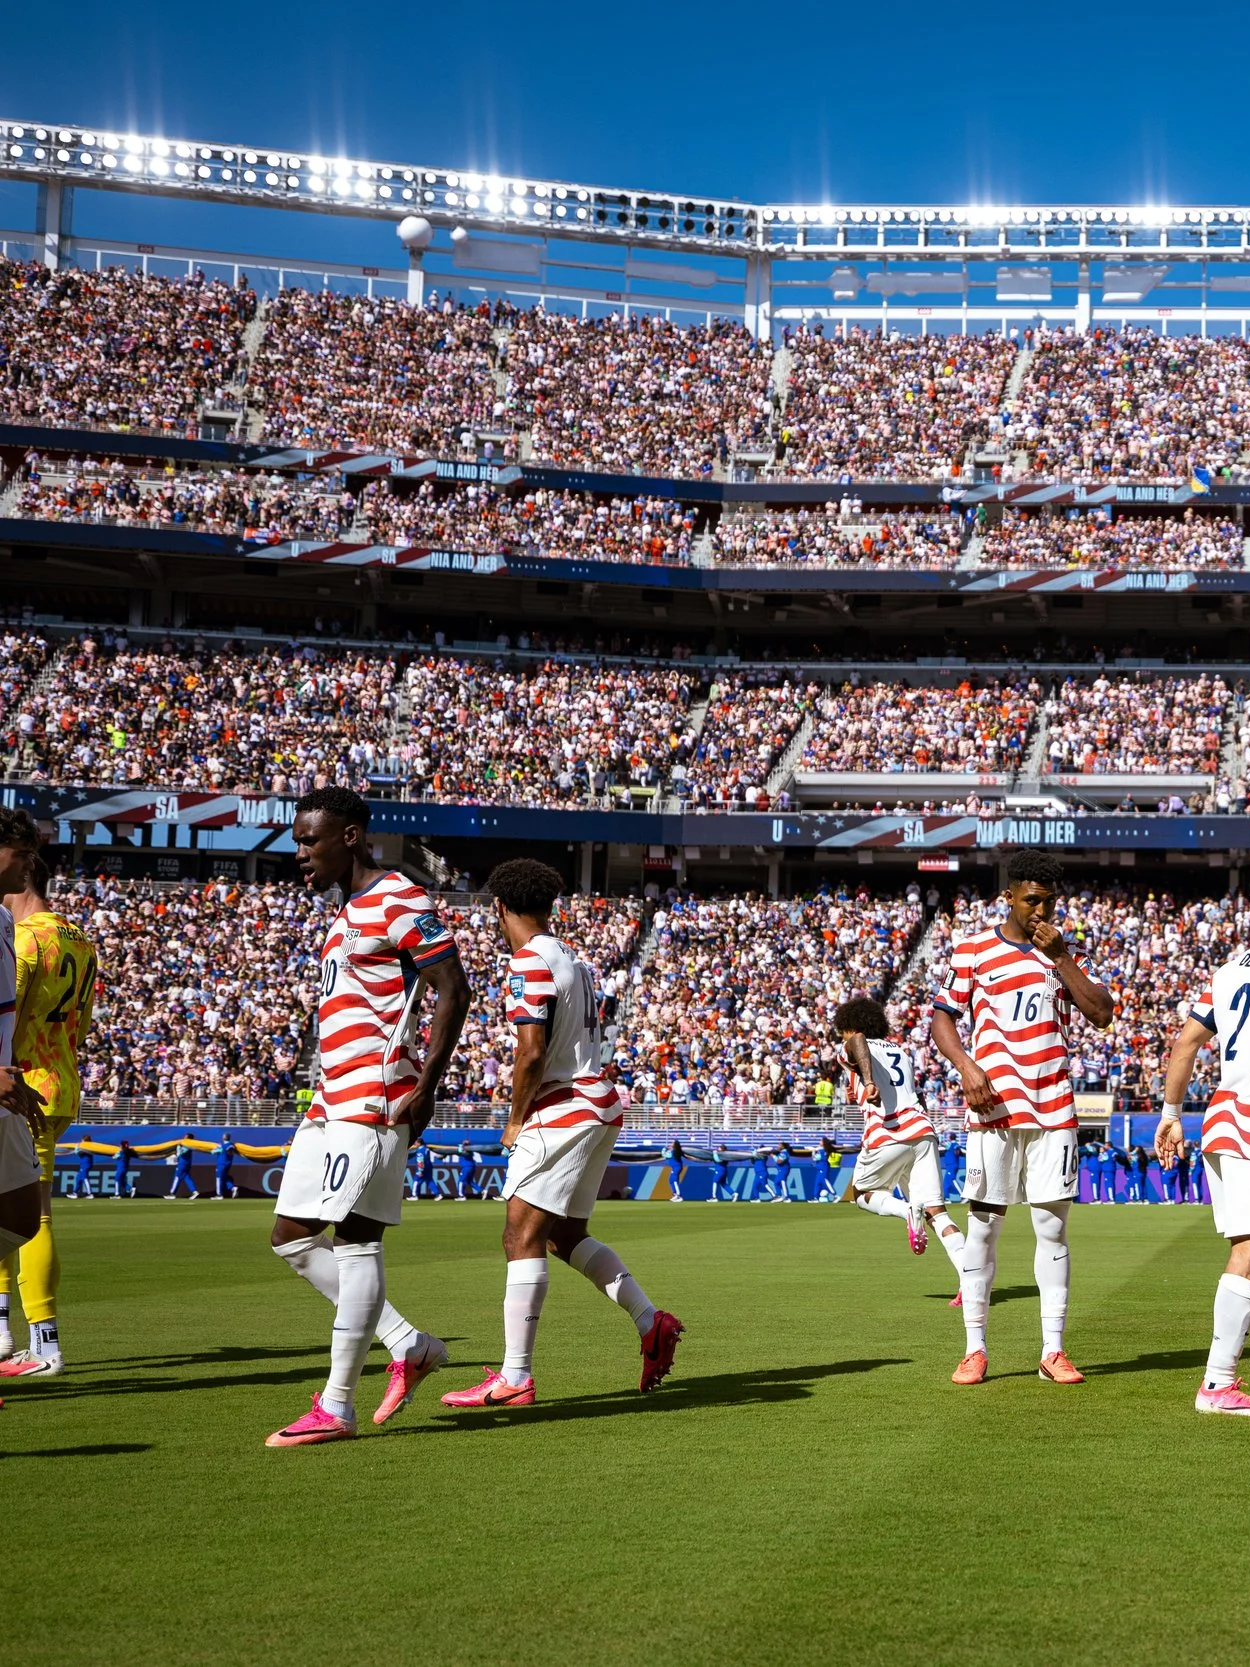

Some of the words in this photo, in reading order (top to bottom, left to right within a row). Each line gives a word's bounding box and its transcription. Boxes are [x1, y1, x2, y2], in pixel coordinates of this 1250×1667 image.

[273, 801, 298, 826] AN
[772, 819, 783, 843] U
[903, 819, 924, 843] SA
[976, 821, 1004, 844] NIA
[1008, 821, 1041, 844] AND
[1045, 820, 1075, 844] HER
[157, 857, 180, 867] FIFA
[213, 861, 239, 871] FIFA
[1012, 991, 1041, 1023] 16
[886, 1052, 905, 1087] 3
[1062, 1144, 1078, 1176] 16
[53, 1170, 141, 1193] TREET
